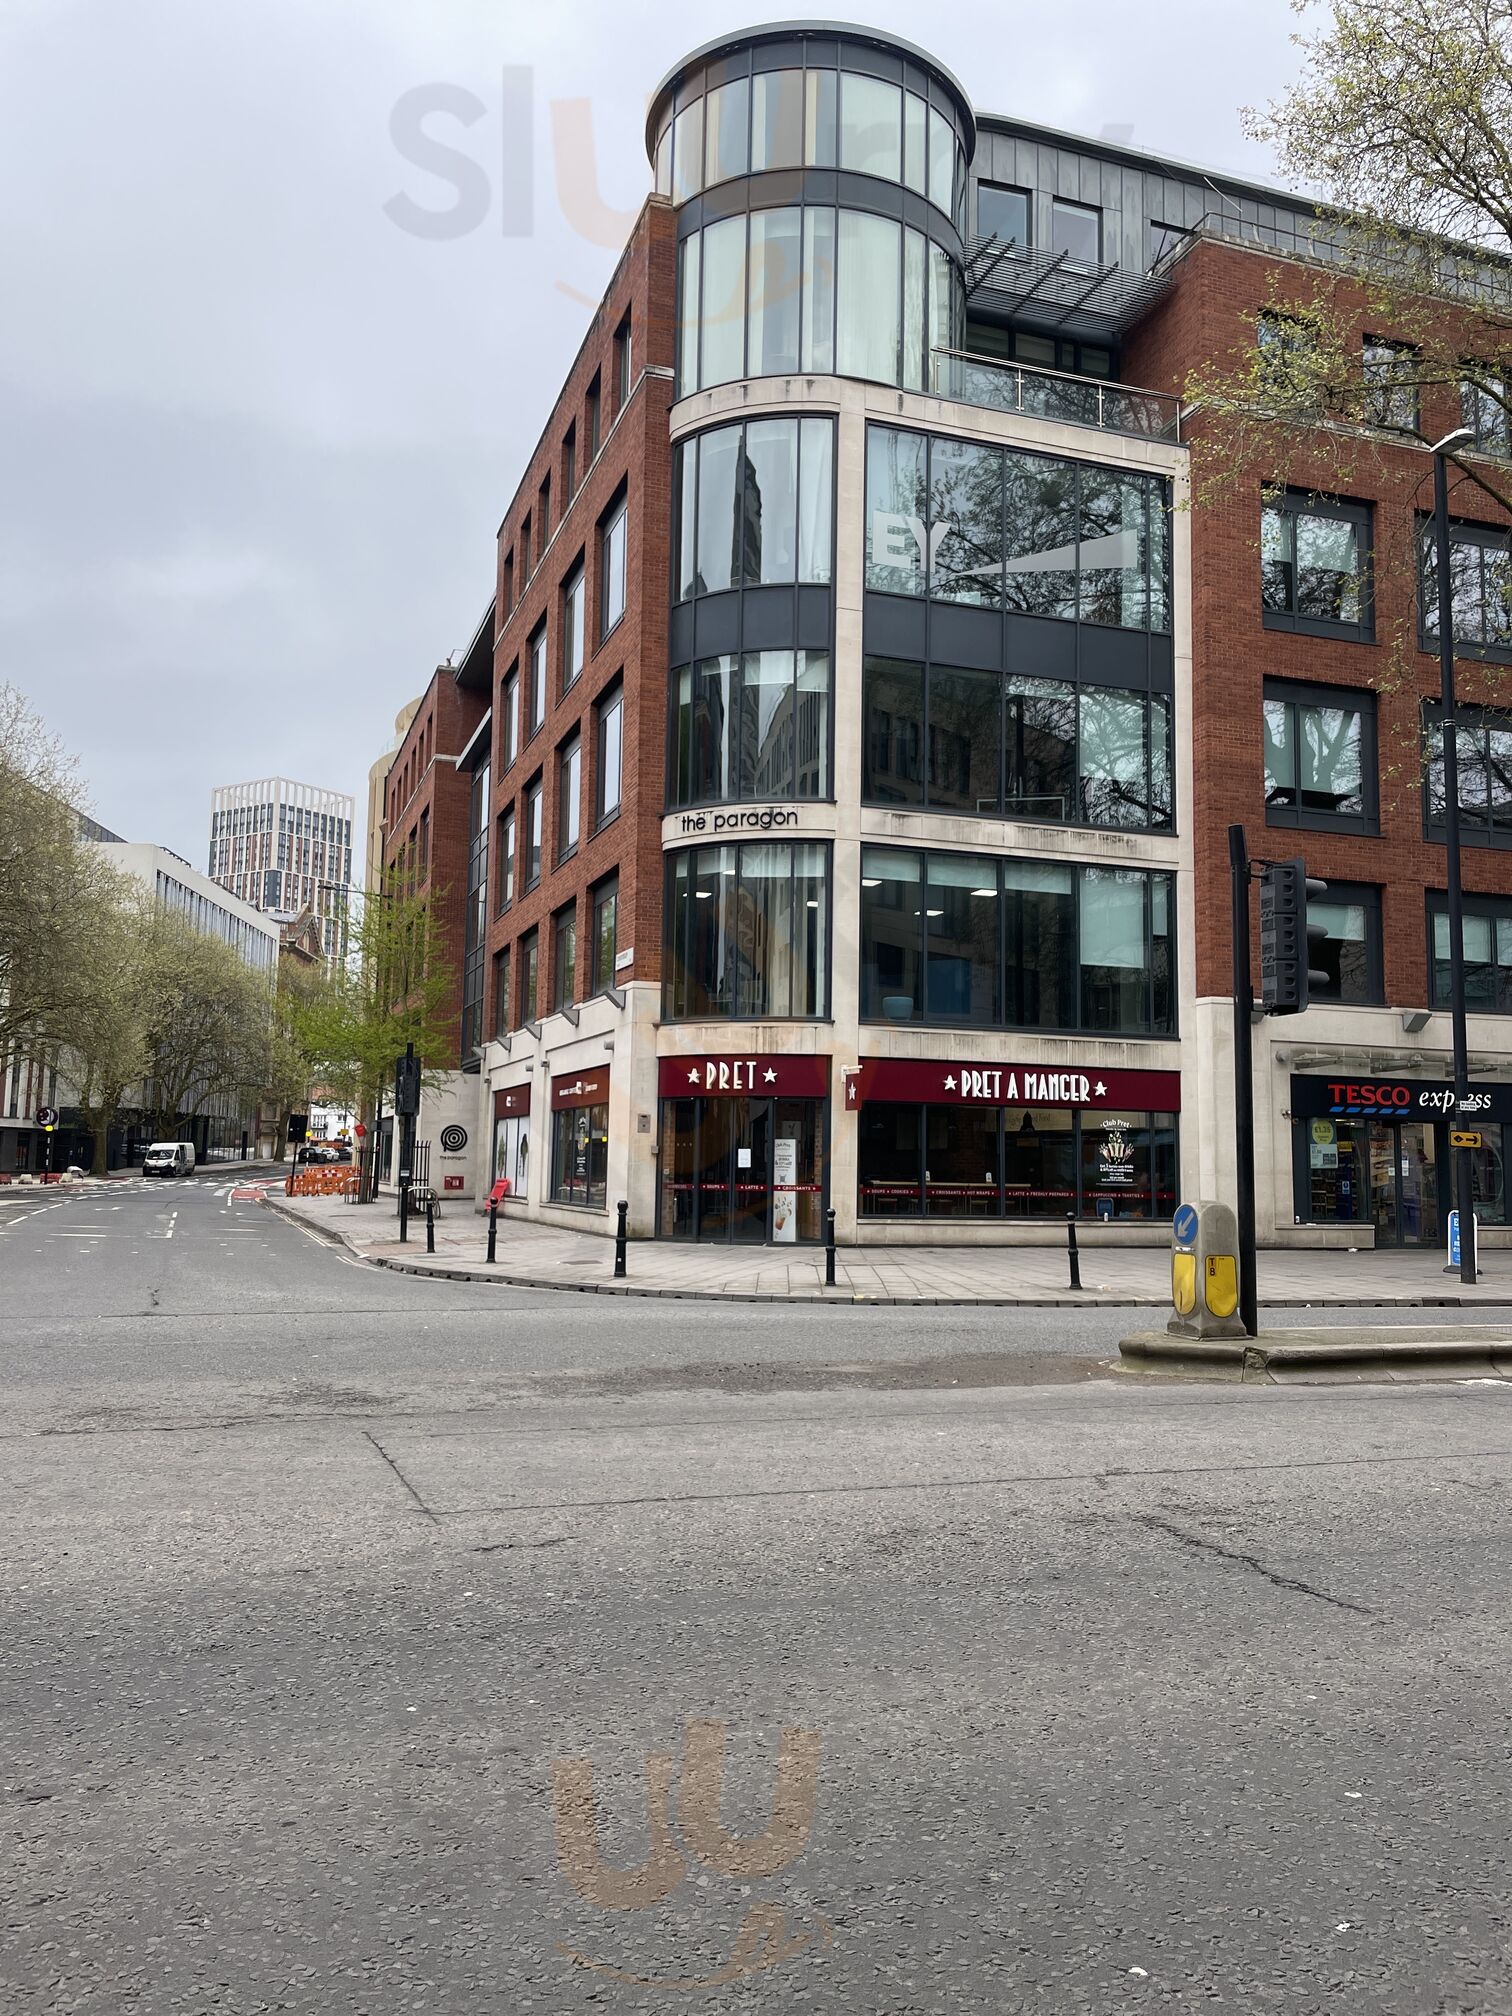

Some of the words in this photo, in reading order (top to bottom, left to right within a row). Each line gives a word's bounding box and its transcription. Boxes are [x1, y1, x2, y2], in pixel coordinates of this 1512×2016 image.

[872, 511, 951, 573] EY
[682, 815, 706, 832] the
[714, 811, 798, 832] paragon
[706, 1061, 757, 1089] PRET
[961, 1070, 1002, 1098] PRET
[1007, 1072, 1019, 1099] A
[1024, 1072, 1091, 1102] MANGER
[1328, 1084, 1411, 1106] TESCO
[1419, 1089, 1492, 1113] expss
[1102, 1119, 1117, 1128] Club
[1117, 1119, 1130, 1128] Pret
